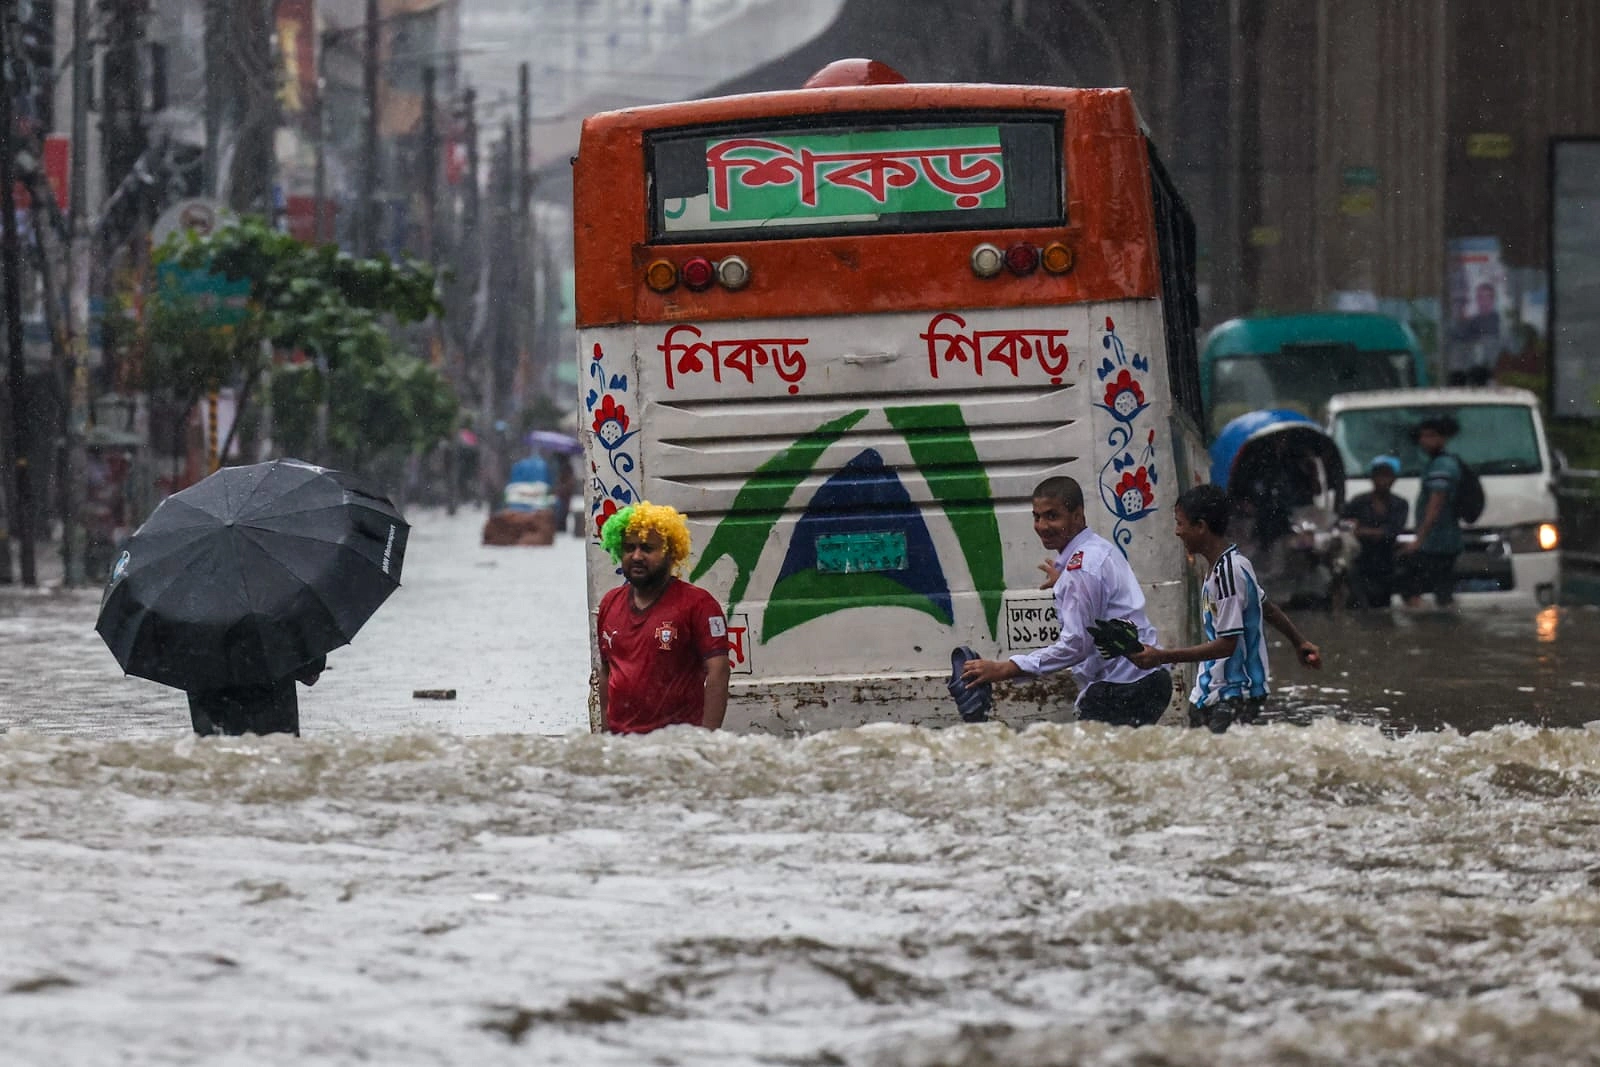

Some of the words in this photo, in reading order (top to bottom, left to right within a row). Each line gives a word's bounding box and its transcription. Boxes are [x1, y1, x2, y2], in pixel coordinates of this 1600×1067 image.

[706, 139, 1004, 210] শিকড়
[656, 324, 810, 396] শিকড়
[920, 312, 1070, 386] শিকড়
[1010, 608, 1043, 623] ঢাকা
